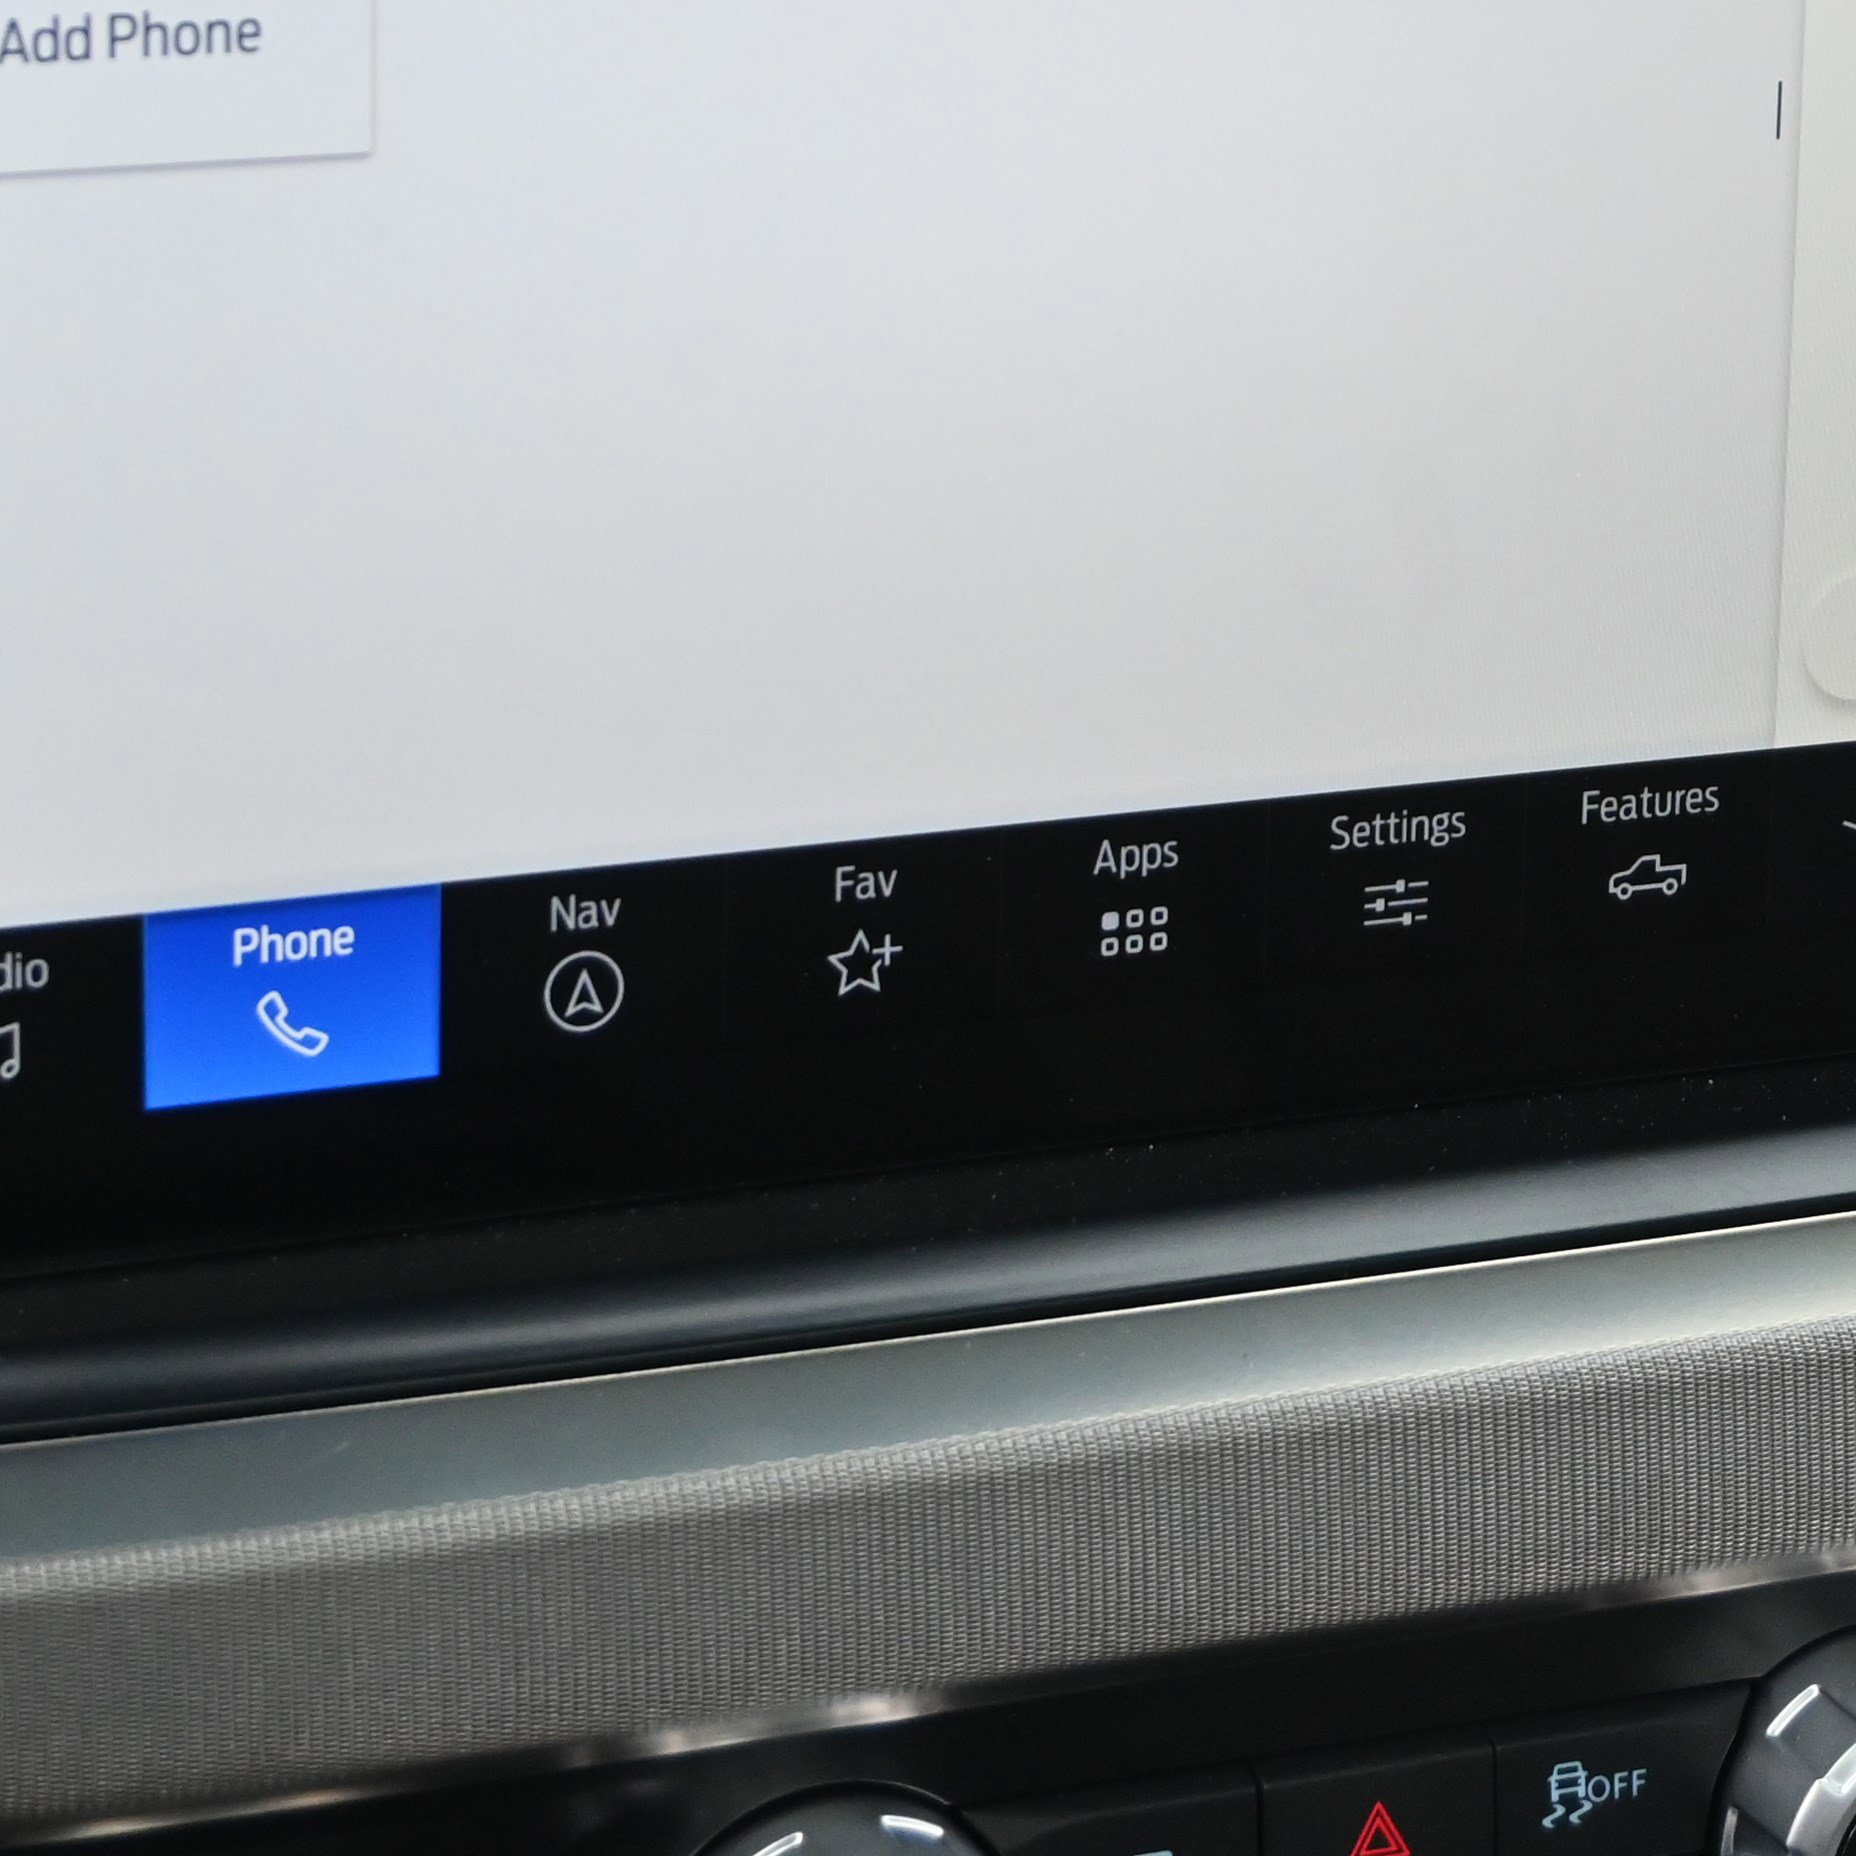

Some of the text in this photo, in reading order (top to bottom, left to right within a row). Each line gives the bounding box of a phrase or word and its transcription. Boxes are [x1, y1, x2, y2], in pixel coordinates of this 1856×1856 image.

[108, 12, 261, 59] Phone
[1581, 786, 1719, 824] Features
[1330, 810, 1466, 851] Settings
[1093, 839, 1179, 879] Apps
[835, 865, 897, 902] Fav
[551, 895, 621, 932] Nav
[233, 925, 355, 966] Phone
[1587, 1769, 1647, 1802] OFF
